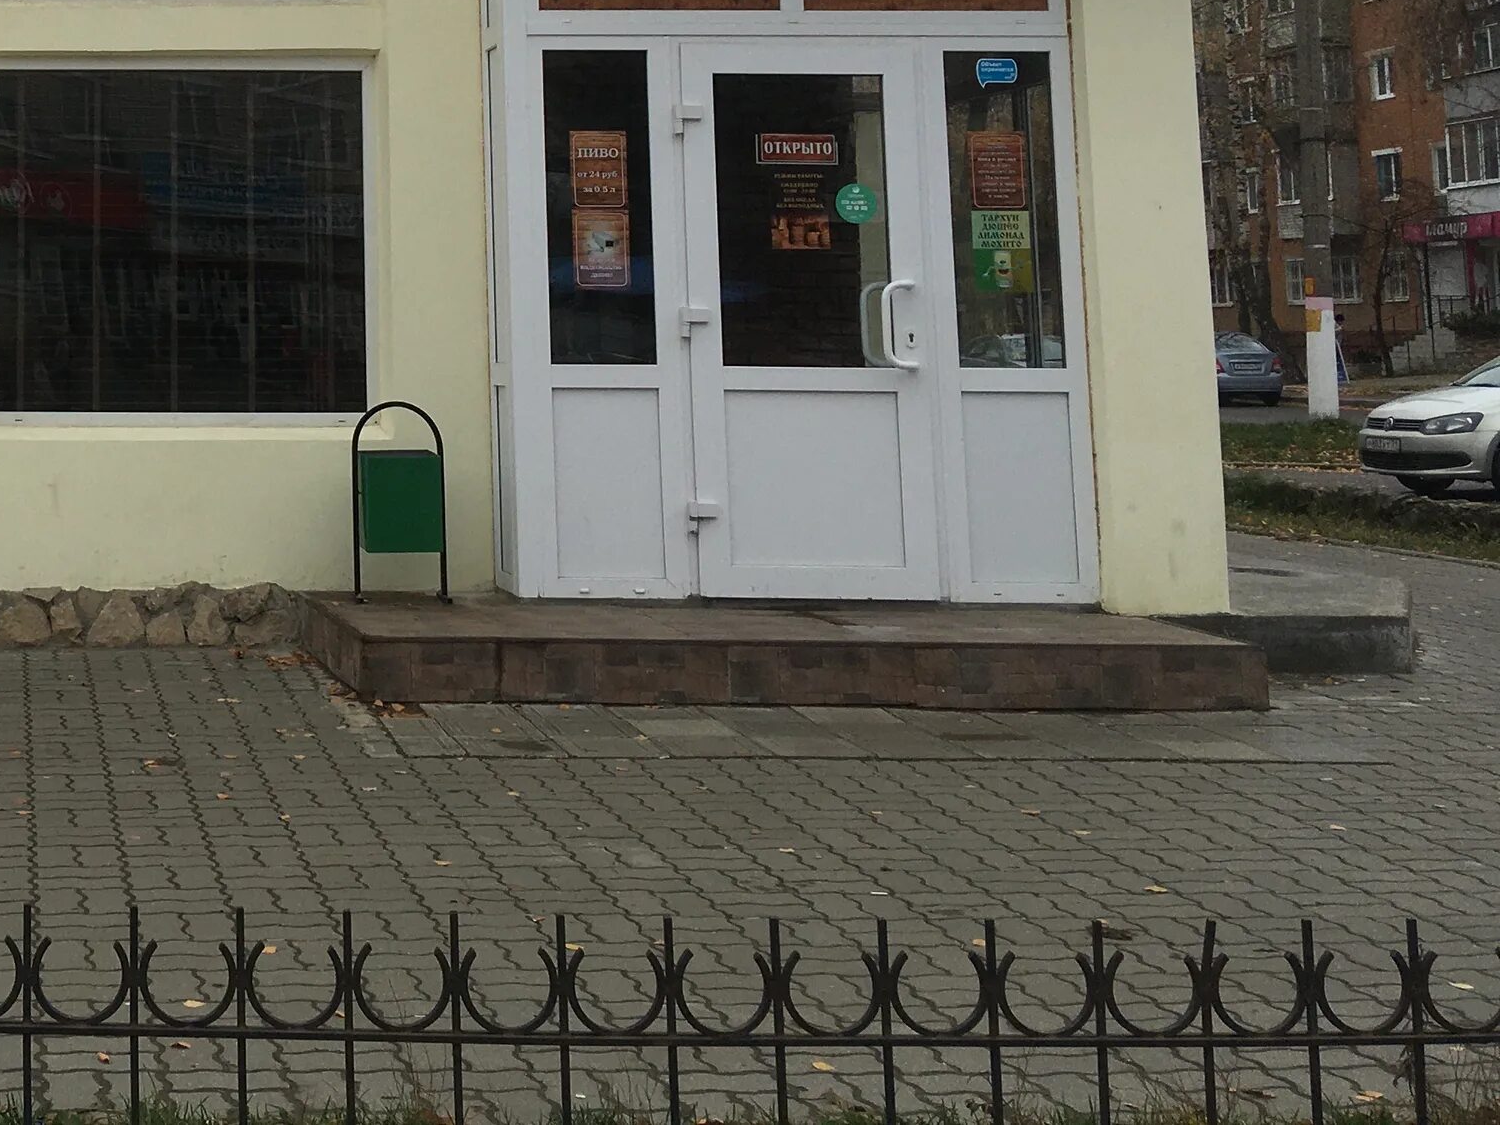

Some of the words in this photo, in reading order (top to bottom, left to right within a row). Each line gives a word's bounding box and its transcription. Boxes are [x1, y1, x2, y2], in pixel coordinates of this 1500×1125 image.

[764, 141, 832, 155] ОТКРЫТО
[577, 147, 619, 158] ПИВО
[589, 170, 600, 178] 24
[981, 214, 1019, 222] ТАРХУН
[978, 231, 1025, 239] ЛИМОНАД
[981, 240, 1022, 248] МОХИТО
